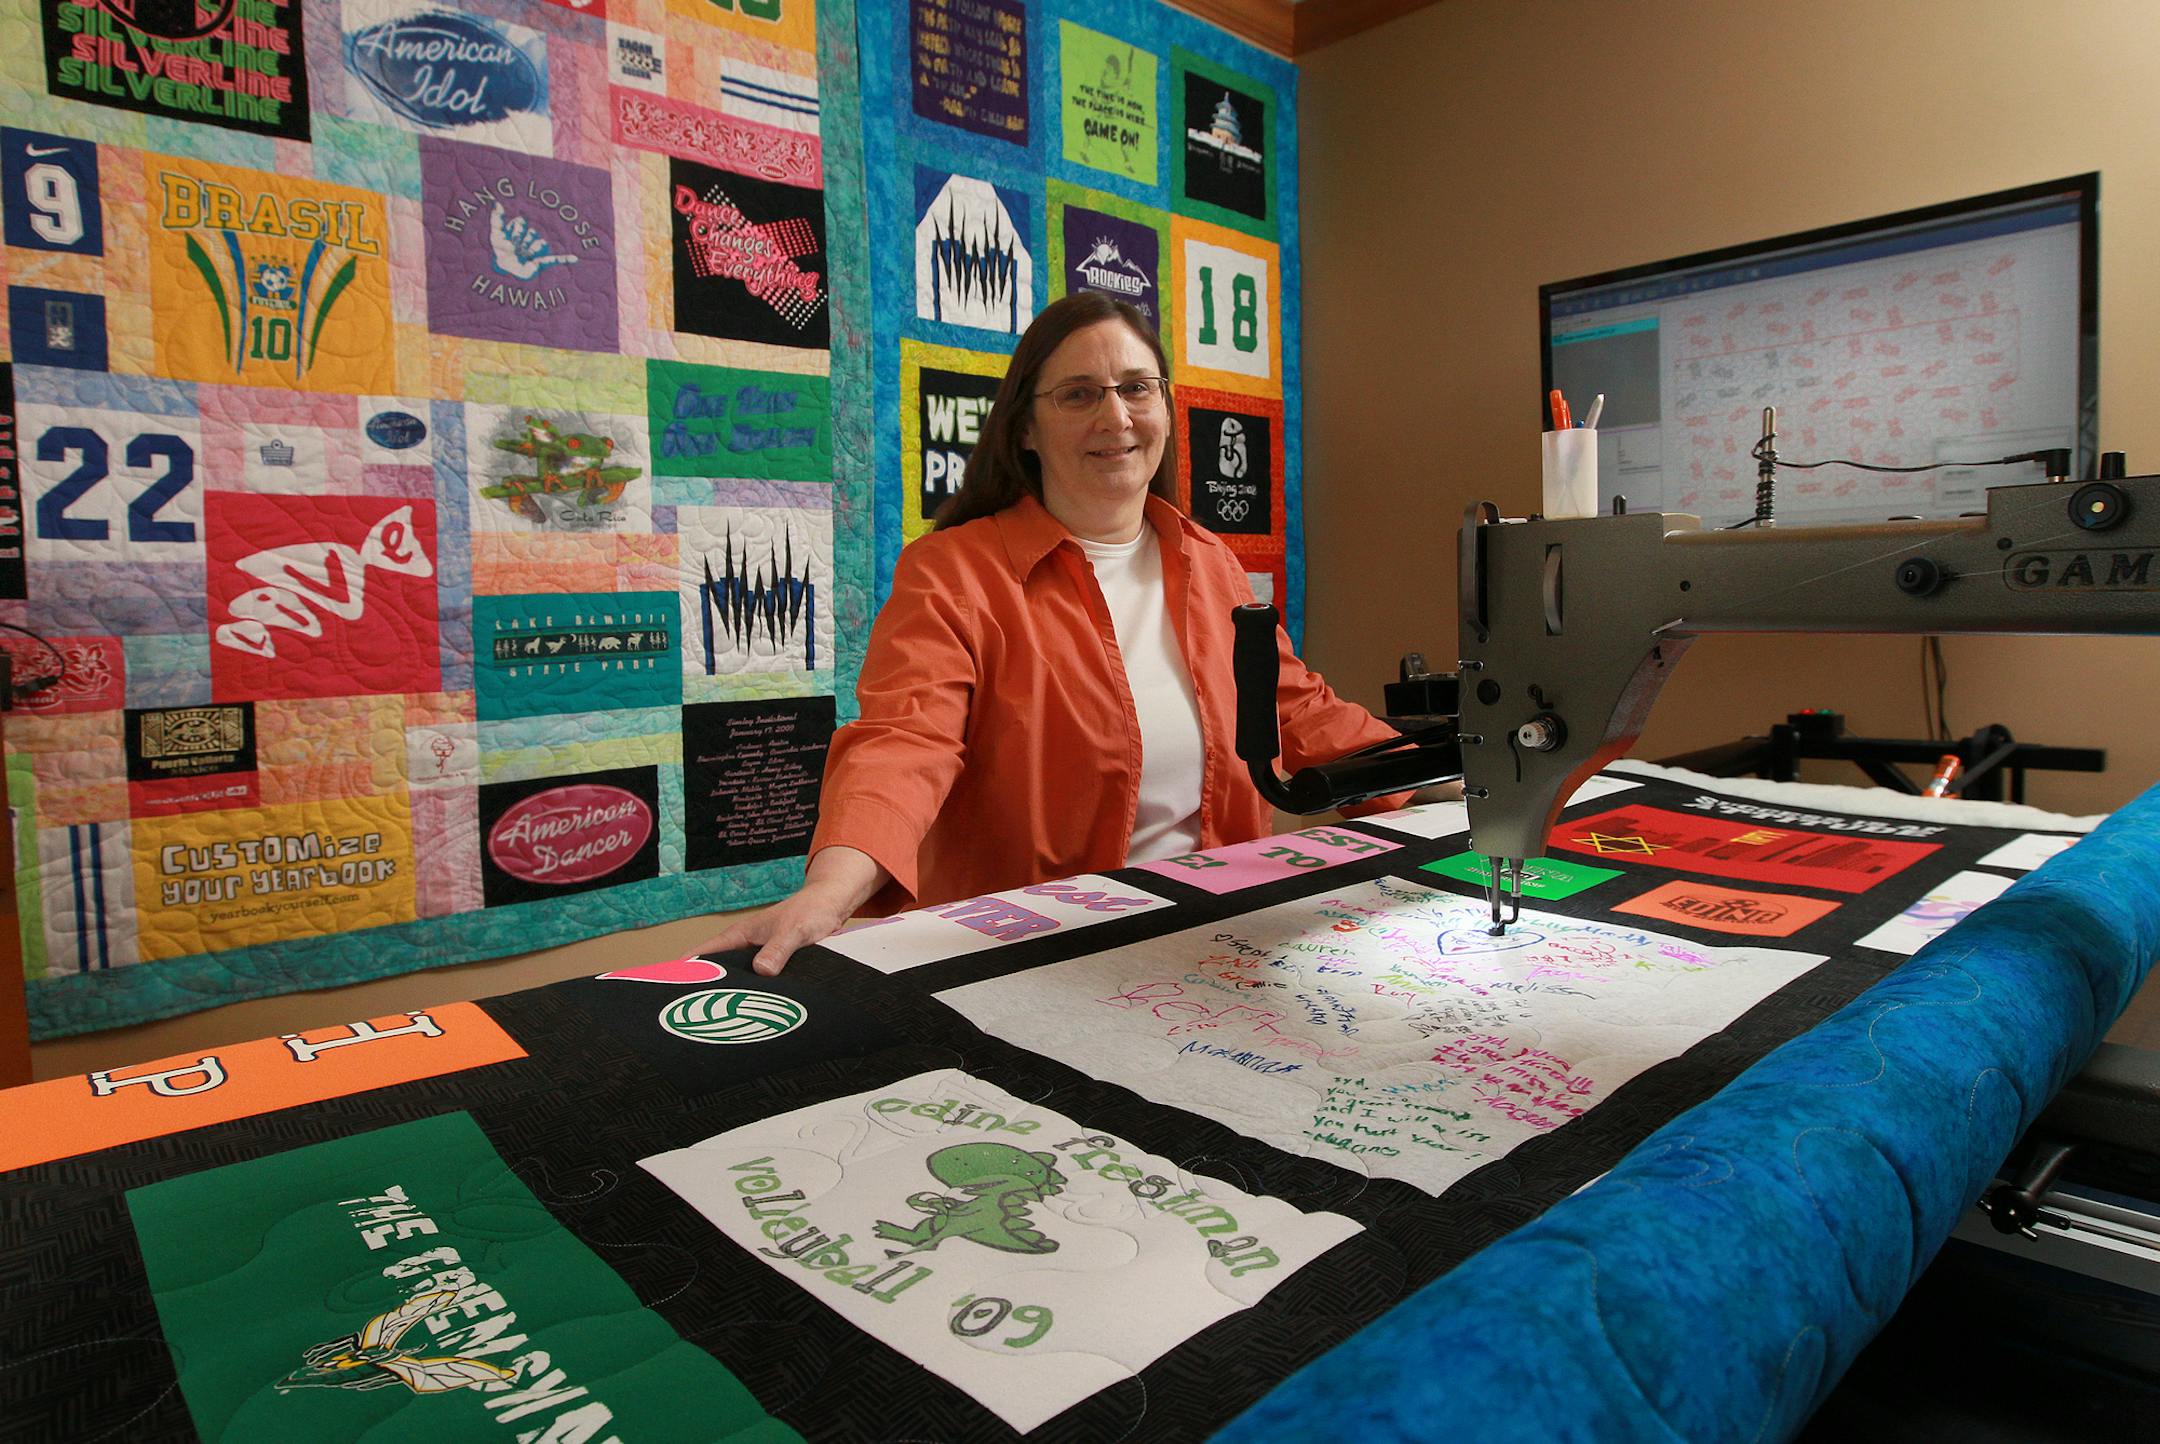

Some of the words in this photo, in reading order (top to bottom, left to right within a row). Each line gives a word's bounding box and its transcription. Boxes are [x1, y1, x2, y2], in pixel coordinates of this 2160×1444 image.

[71, 33, 292, 103] SILVERLINE
[356, 24, 517, 64] American
[58, 57, 281, 124] SILVERLINE
[404, 65, 489, 115] Idol
[1083, 118, 1118, 143] GAME
[24, 162, 85, 245] 9
[160, 171, 380, 256] BRASIL
[444, 178, 515, 232] HANG
[528, 181, 600, 250] LOOSE
[674, 184, 742, 225] Dance
[689, 218, 773, 264] Changes
[471, 275, 567, 310] HAWAII
[709, 250, 820, 301] Everything
[1198, 266, 1259, 354] 18
[250, 316, 292, 361] 10
[926, 394, 996, 444] WE'
[37, 426, 196, 543] 22
[1205, 480, 1237, 498] Beijing
[596, 510, 627, 522] Rica
[495, 616, 554, 631] LAKE
[508, 661, 582, 678] STATE
[601, 658, 655, 672] PARK
[496, 799, 638, 847] American
[532, 830, 633, 876] Dancer
[337, 1184, 440, 1252] THE
